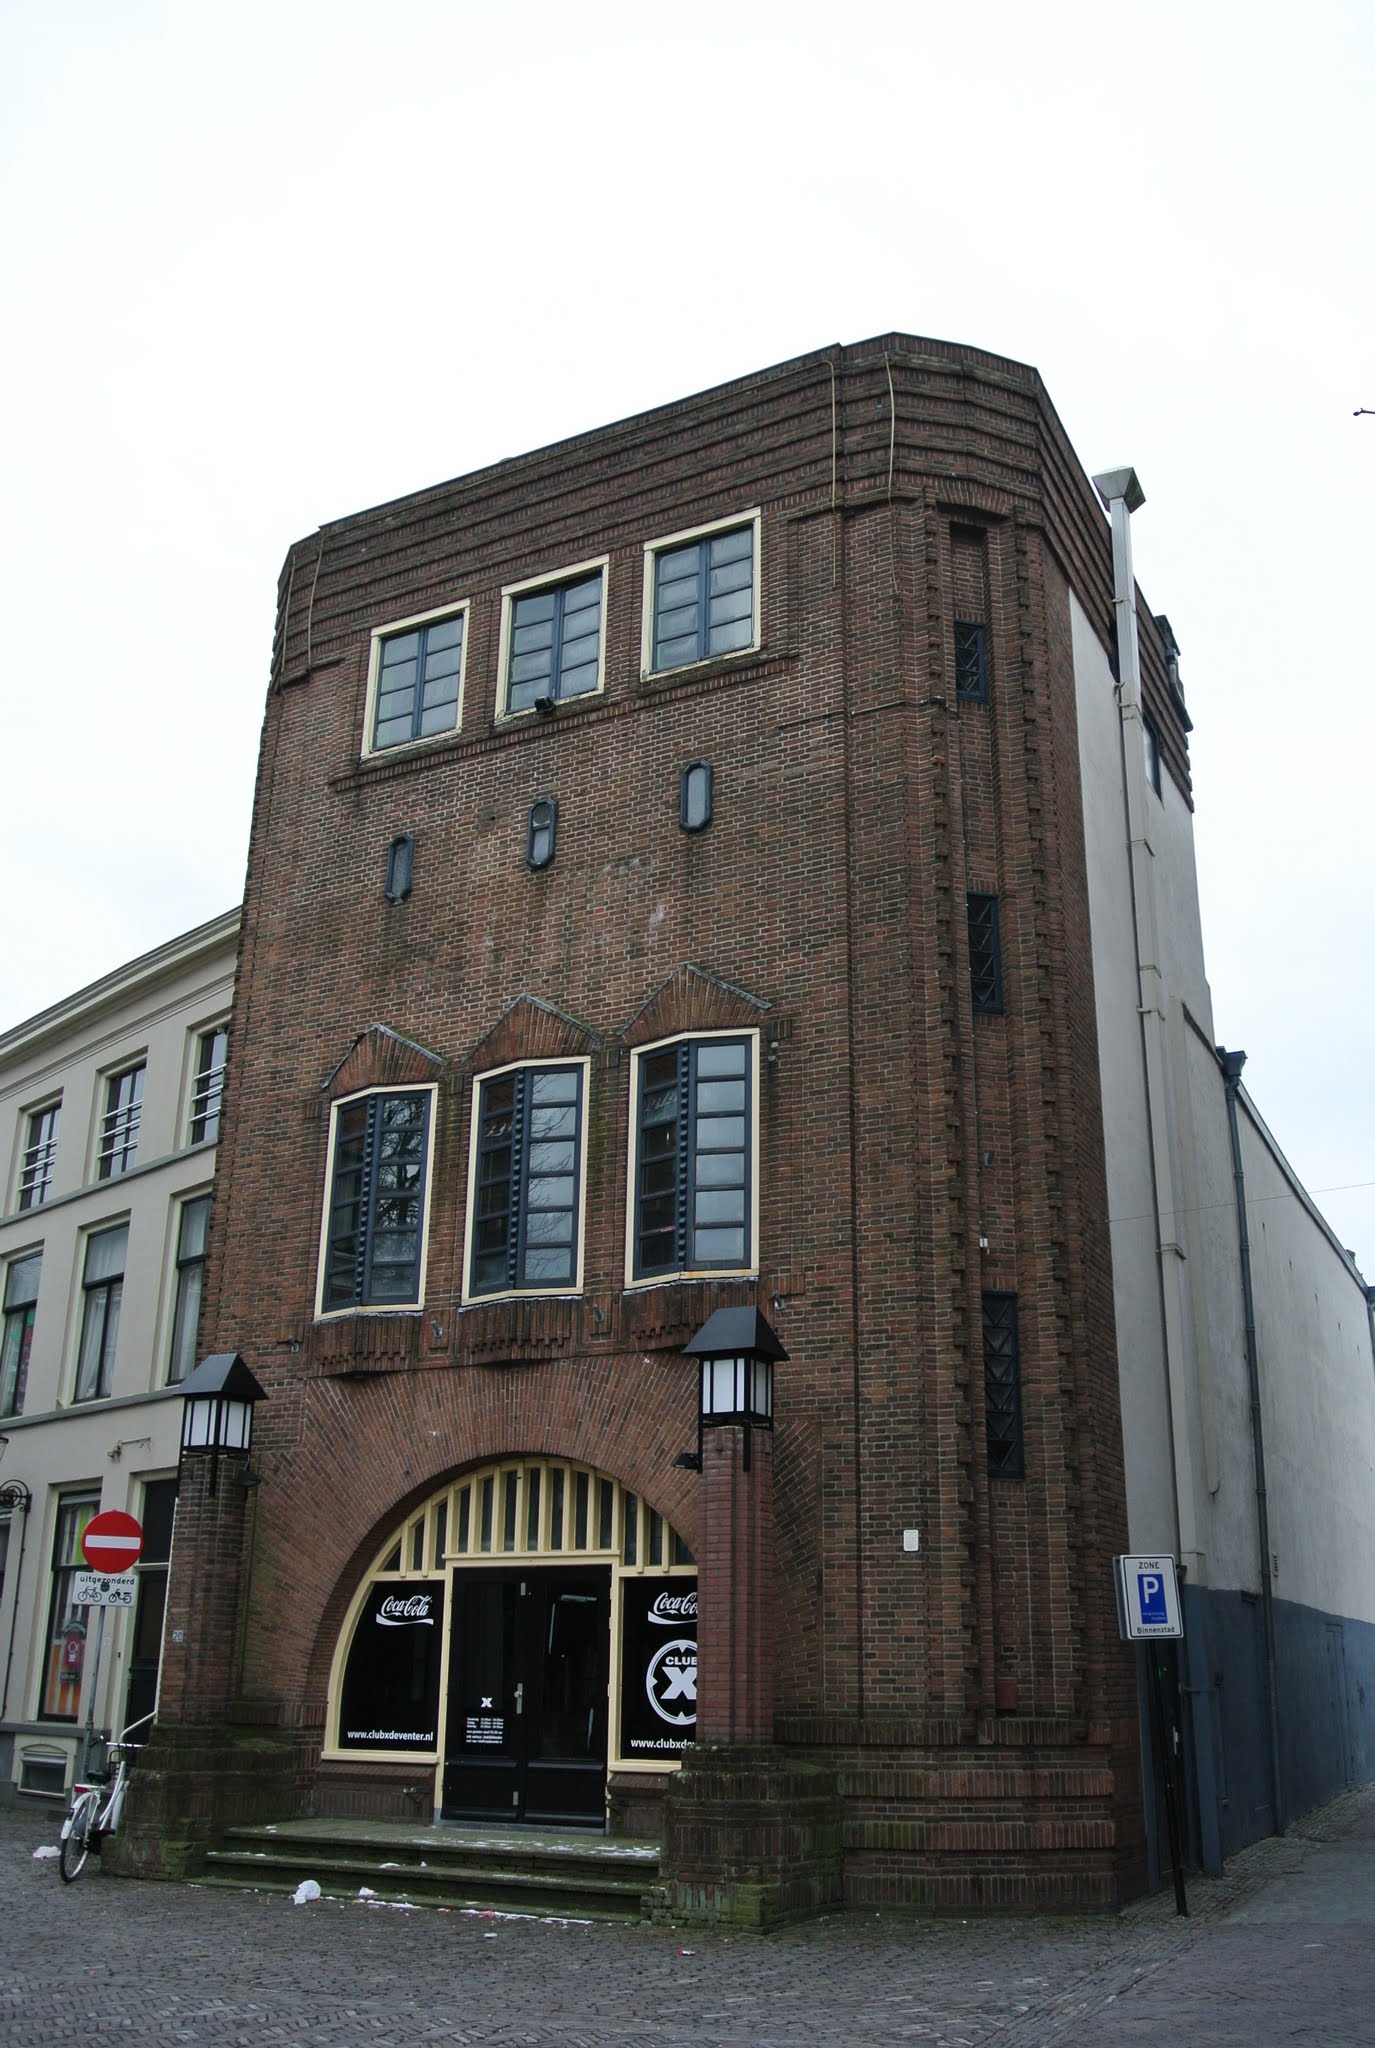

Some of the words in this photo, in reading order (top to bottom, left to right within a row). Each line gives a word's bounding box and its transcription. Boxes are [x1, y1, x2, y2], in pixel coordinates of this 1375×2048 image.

[80, 1575, 135, 1585] uitgezonderd
[1143, 1577, 1159, 1603] P
[381, 1595, 432, 1617] Coca-Cola
[653, 1592, 698, 1615] Coca-Co
[1137, 1626, 1175, 1634] Binnenstad
[661, 1667, 697, 1700] X
[347, 1730, 434, 1741] www.clubxdeventer.nl
